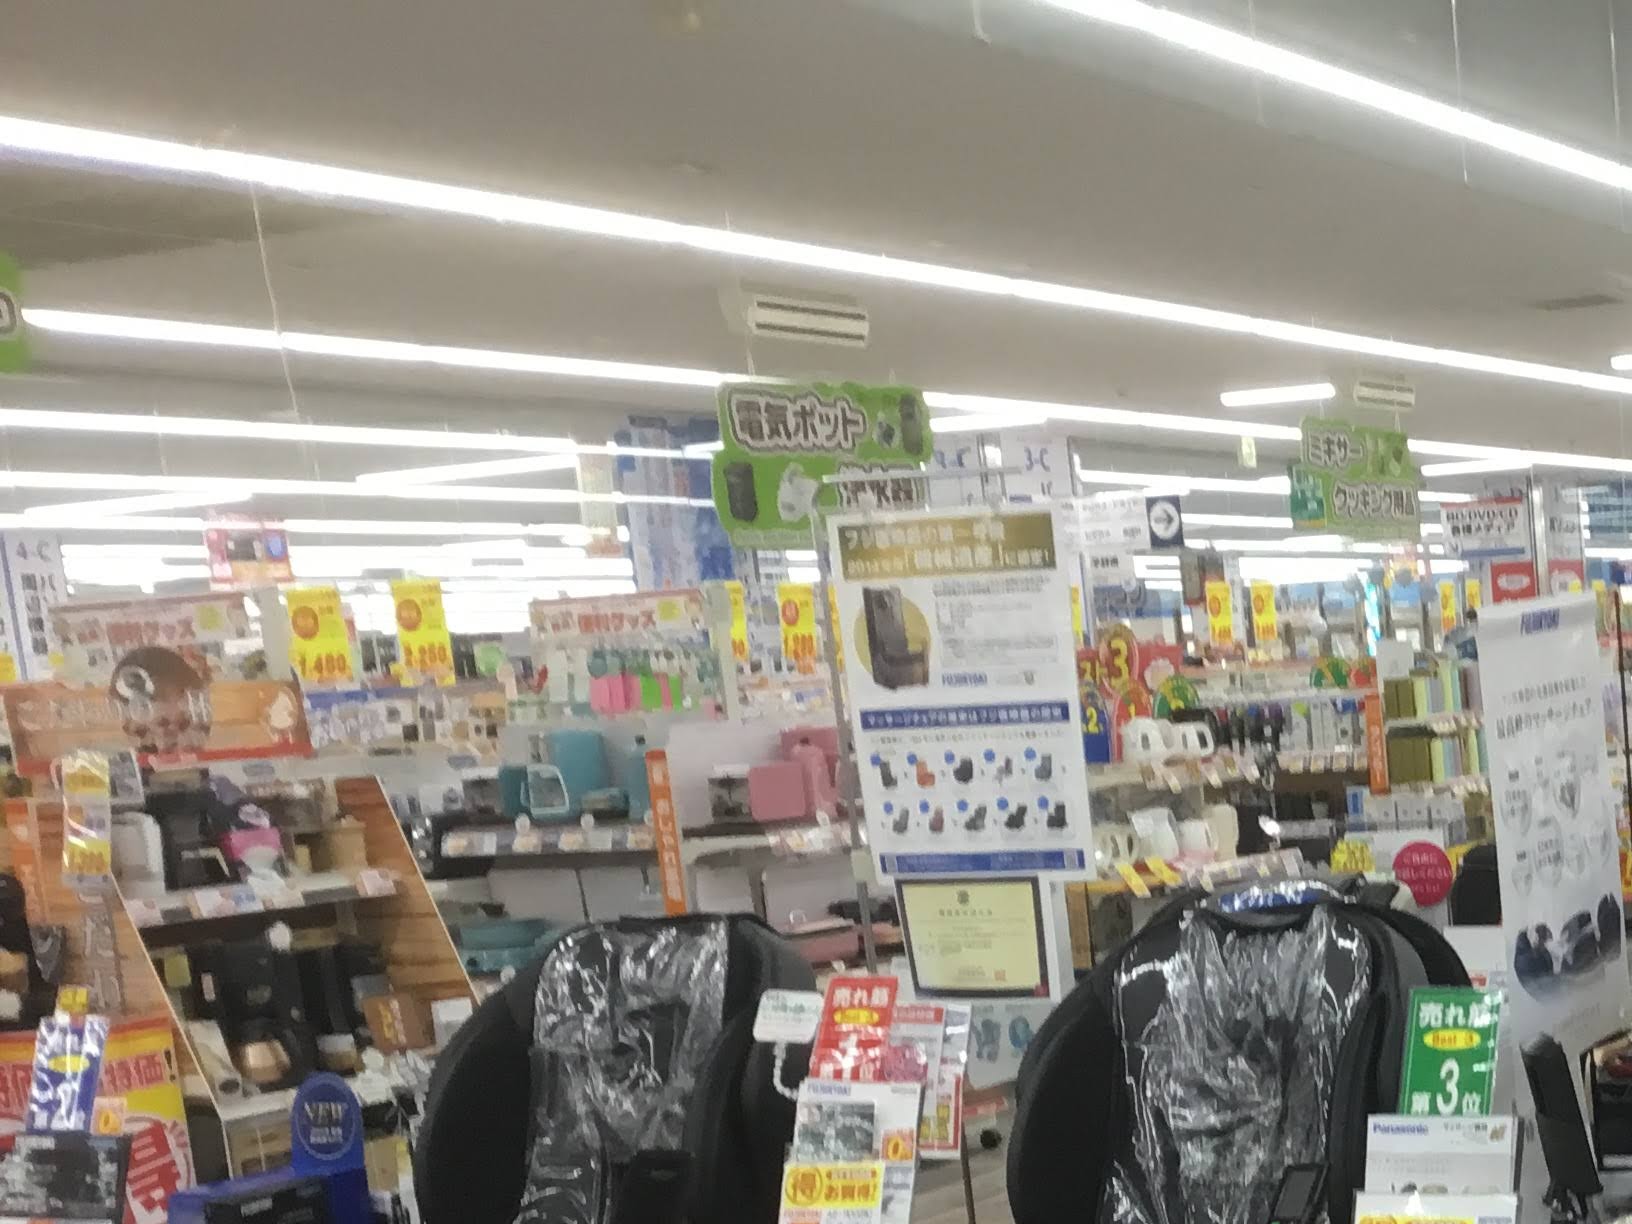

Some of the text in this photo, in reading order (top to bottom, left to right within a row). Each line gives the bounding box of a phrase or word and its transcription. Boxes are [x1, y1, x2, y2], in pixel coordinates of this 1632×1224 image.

[1024, 446, 1049, 471] 3-C
[1309, 432, 1364, 467] ミキサー
[1373, 1122, 1429, 1136] Panasonic
